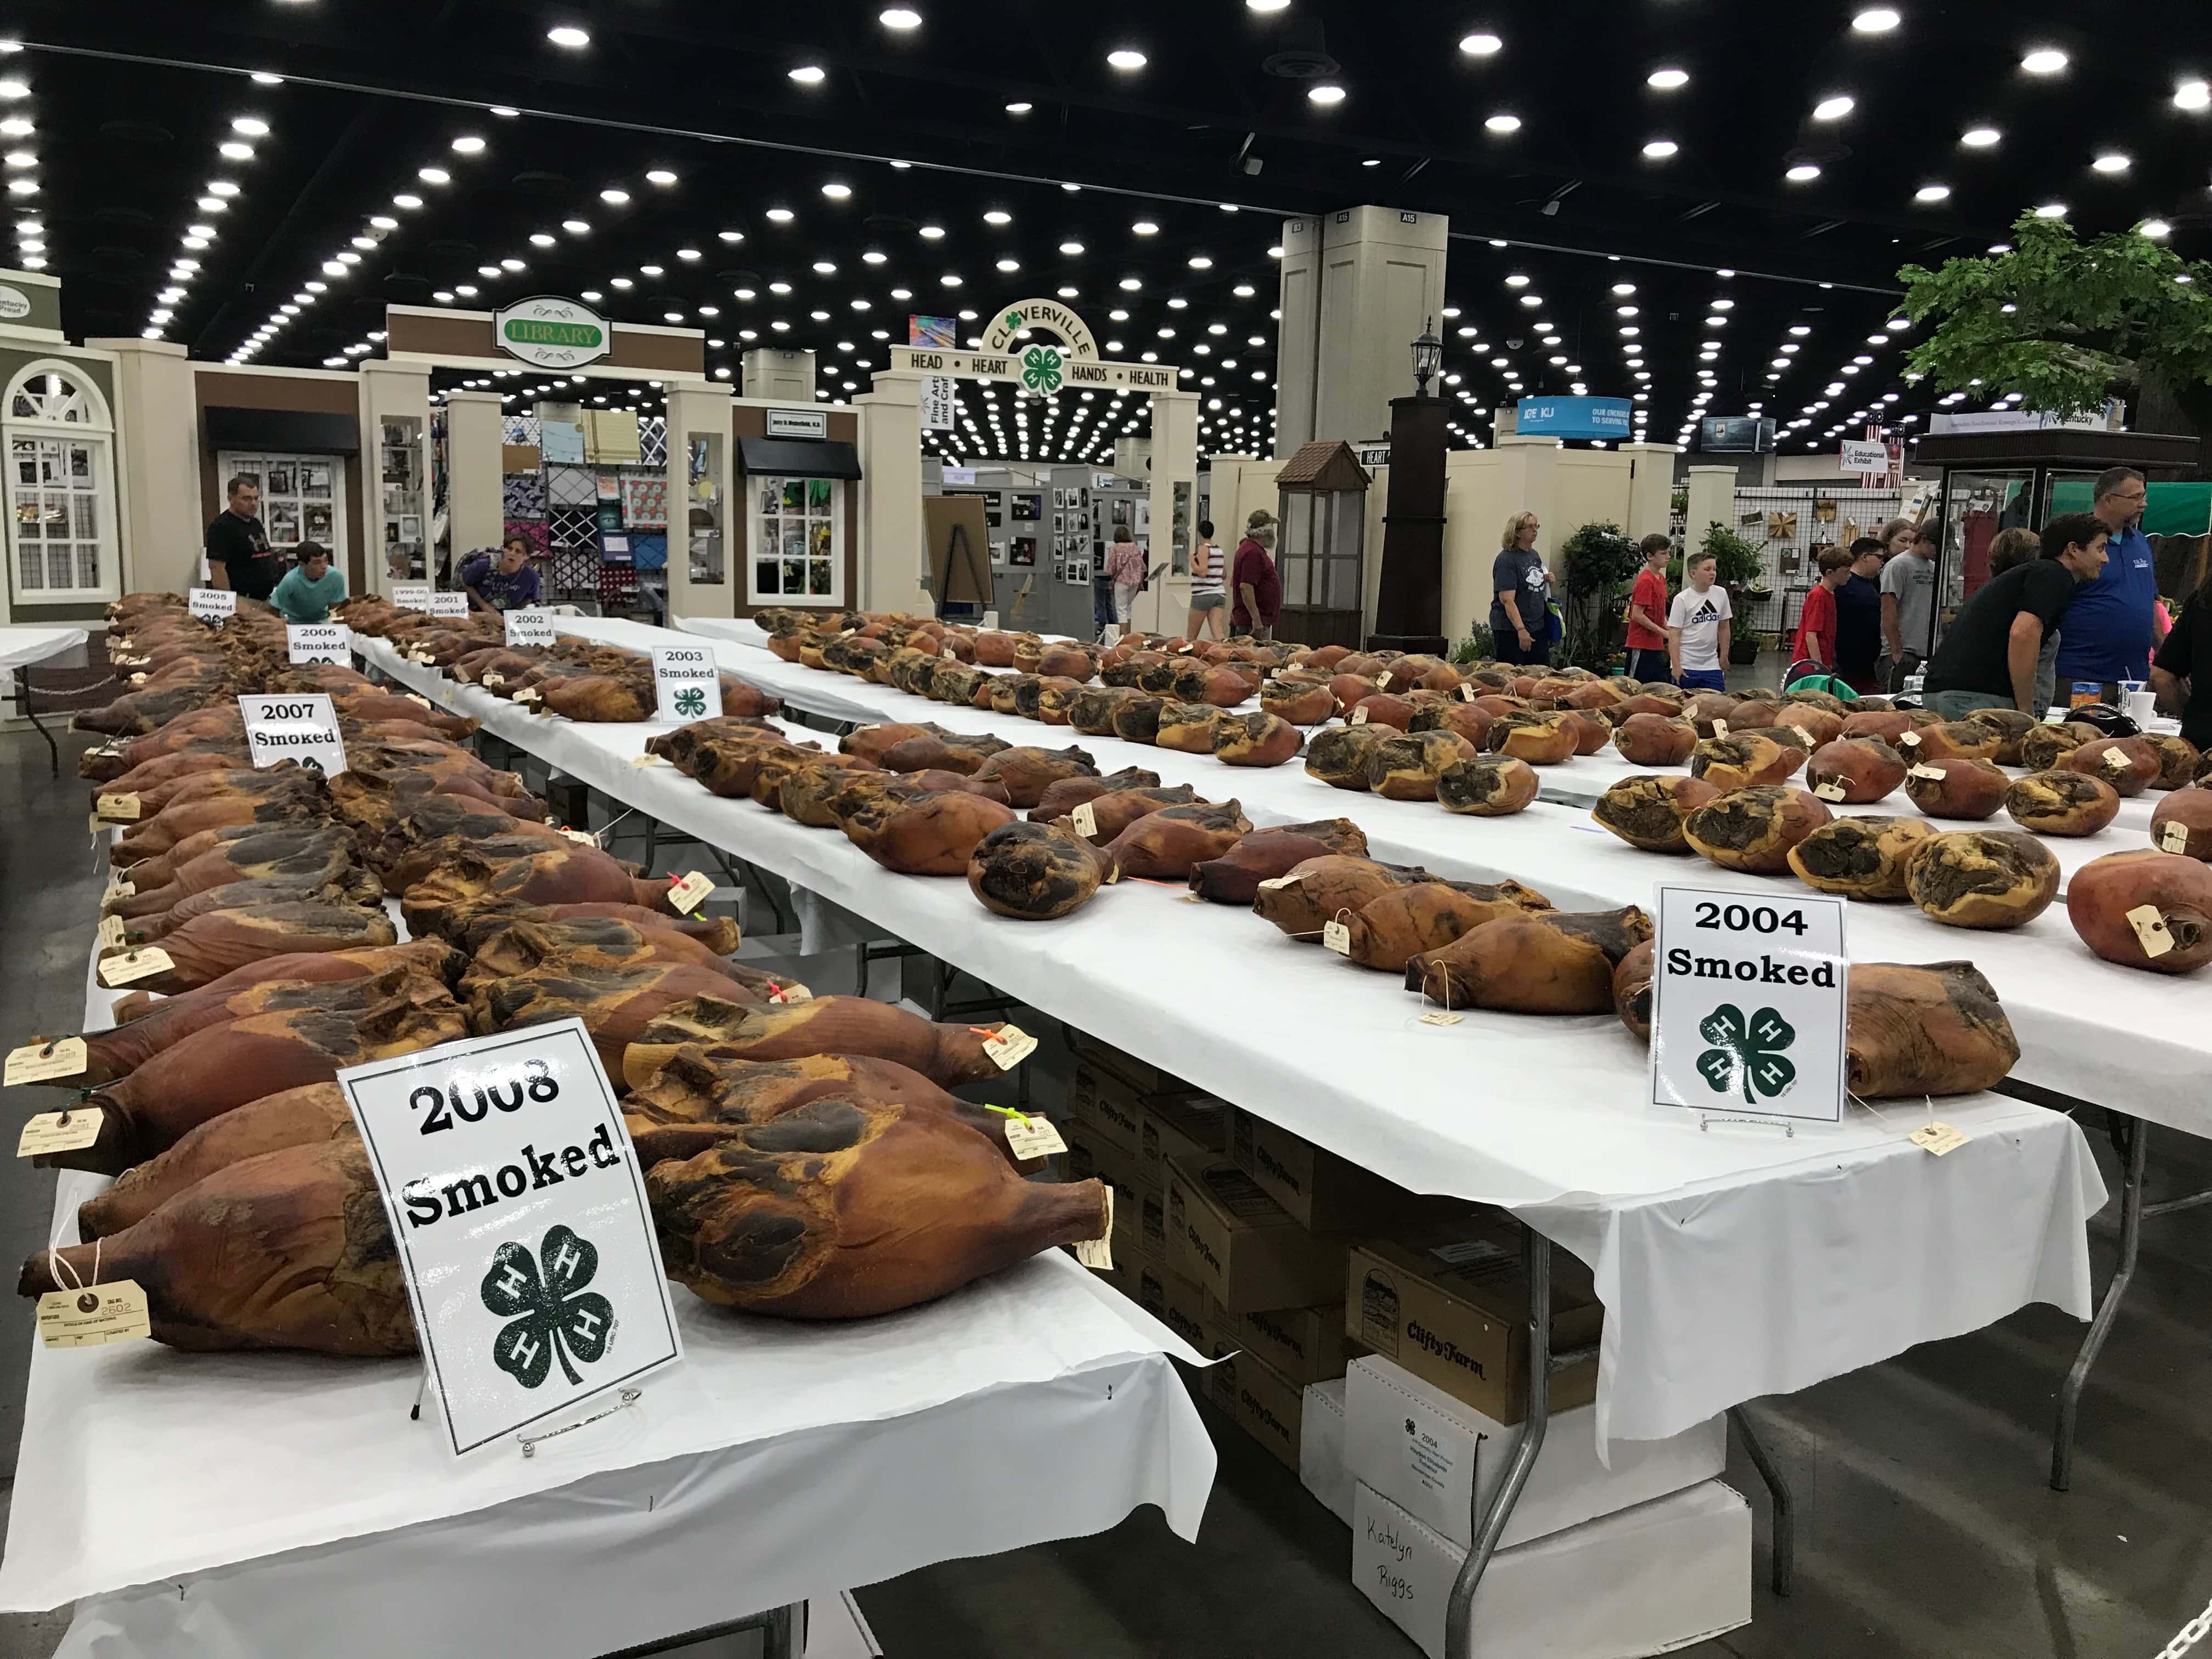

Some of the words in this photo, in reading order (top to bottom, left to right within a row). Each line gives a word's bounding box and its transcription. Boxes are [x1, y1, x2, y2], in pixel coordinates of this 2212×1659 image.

[1402, 214, 1415, 222] A15
[511, 323, 596, 344] LIBRARY
[911, 353, 943, 369] HEAD
[972, 358, 1008, 374] HEART
[1072, 366, 1107, 382] HANDS
[1130, 370, 1169, 386] HEALTH
[931, 400, 939, 424] Fine
[1367, 451, 1386, 464] HEART
[1854, 450, 1884, 459] Educational
[199, 591, 227, 600] 2005
[193, 601, 232, 611] Smoked
[515, 615, 544, 624] 2002
[300, 628, 336, 636] 2006
[293, 641, 346, 650] Smoked
[665, 651, 703, 662] 2003
[659, 668, 714, 678] Smoked
[261, 704, 314, 719] 2007
[255, 728, 336, 746] Smoked
[1695, 902, 1809, 936] 2004
[1667, 948, 1836, 988] Smoked
[409, 1058, 560, 1136] 2008
[401, 1122, 620, 1229] Smoked
[101, 1303, 132, 1316] 2602
[1407, 1320, 1443, 1356] Clifty
[1443, 1341, 1487, 1381] Farm
[1421, 1433, 1437, 1448] 2004
[1367, 1516, 1412, 1561] Katelyn
[1377, 1565, 1414, 1599] Riggs
